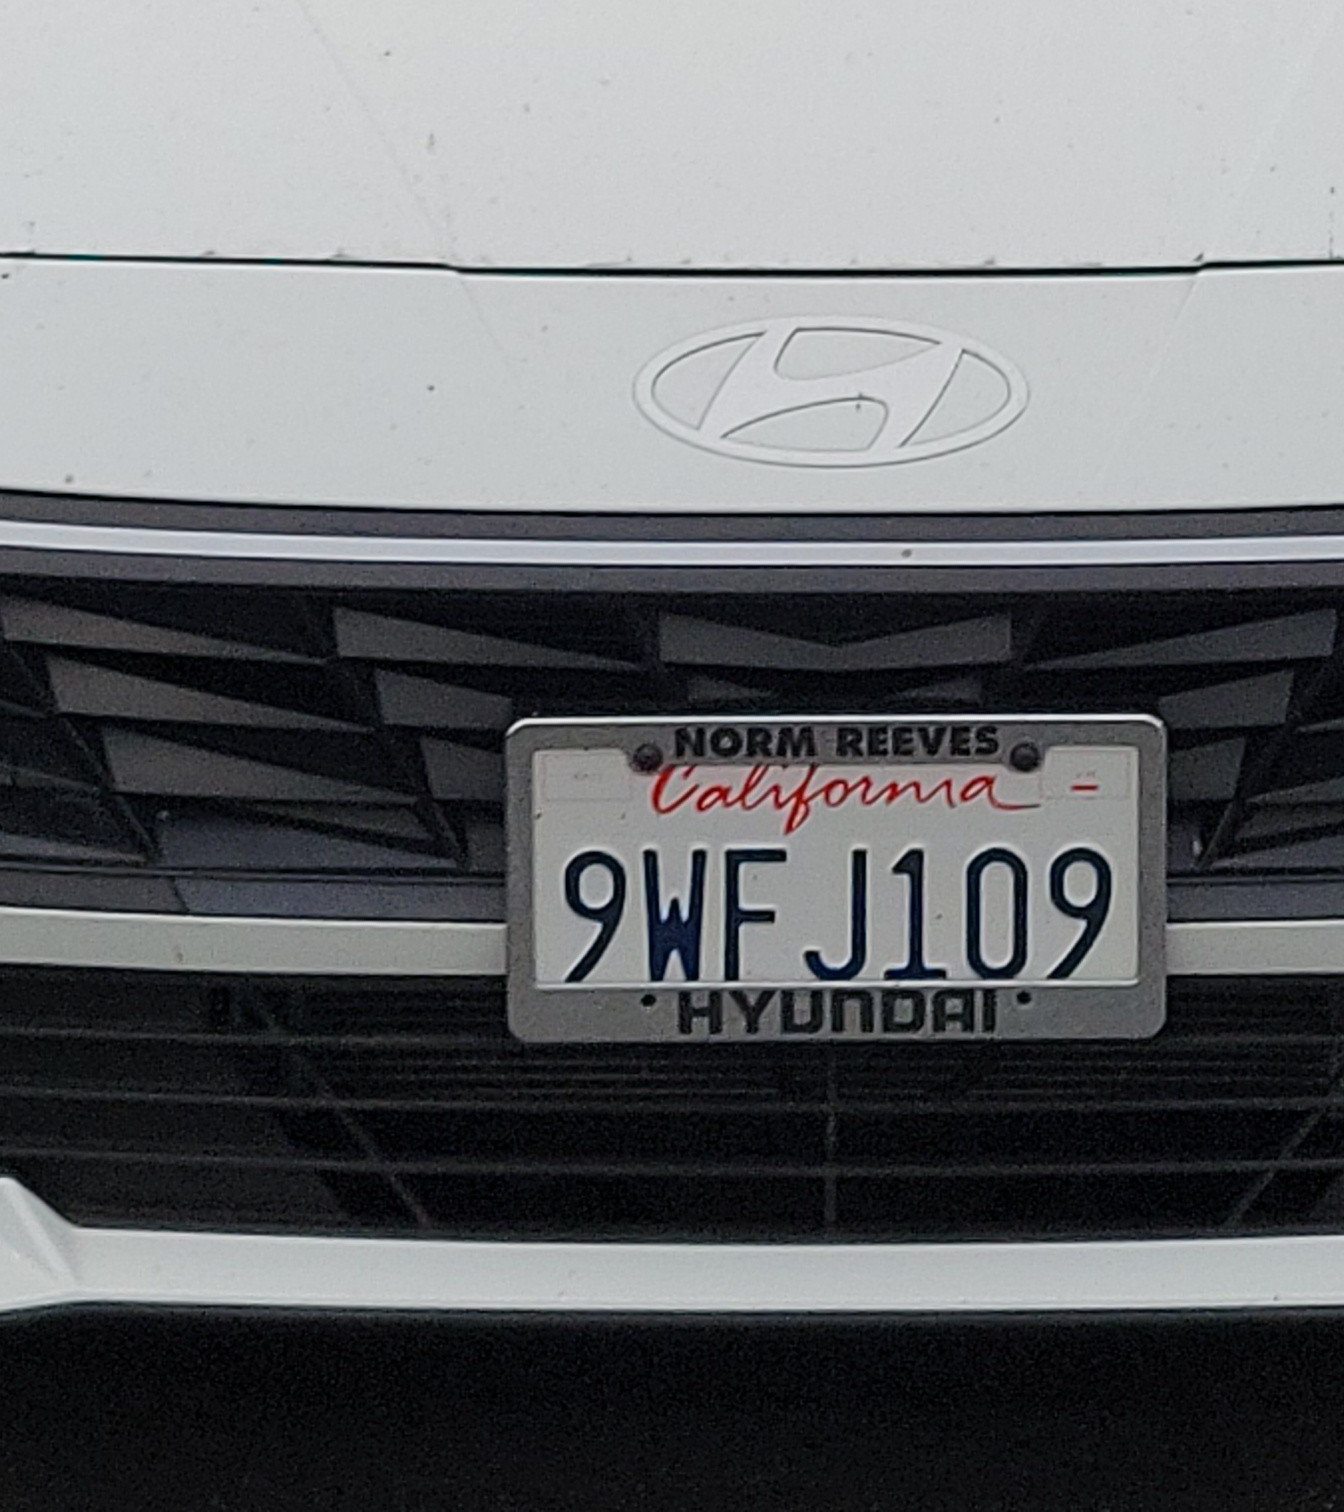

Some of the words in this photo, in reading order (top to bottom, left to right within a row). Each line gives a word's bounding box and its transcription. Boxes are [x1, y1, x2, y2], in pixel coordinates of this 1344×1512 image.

[674, 725, 818, 760] NORM
[836, 724, 1000, 758] REEVES
[651, 763, 1042, 835] California
[563, 846, 1113, 983] 9WFJ109
[677, 988, 999, 1035] HYUNDAI
